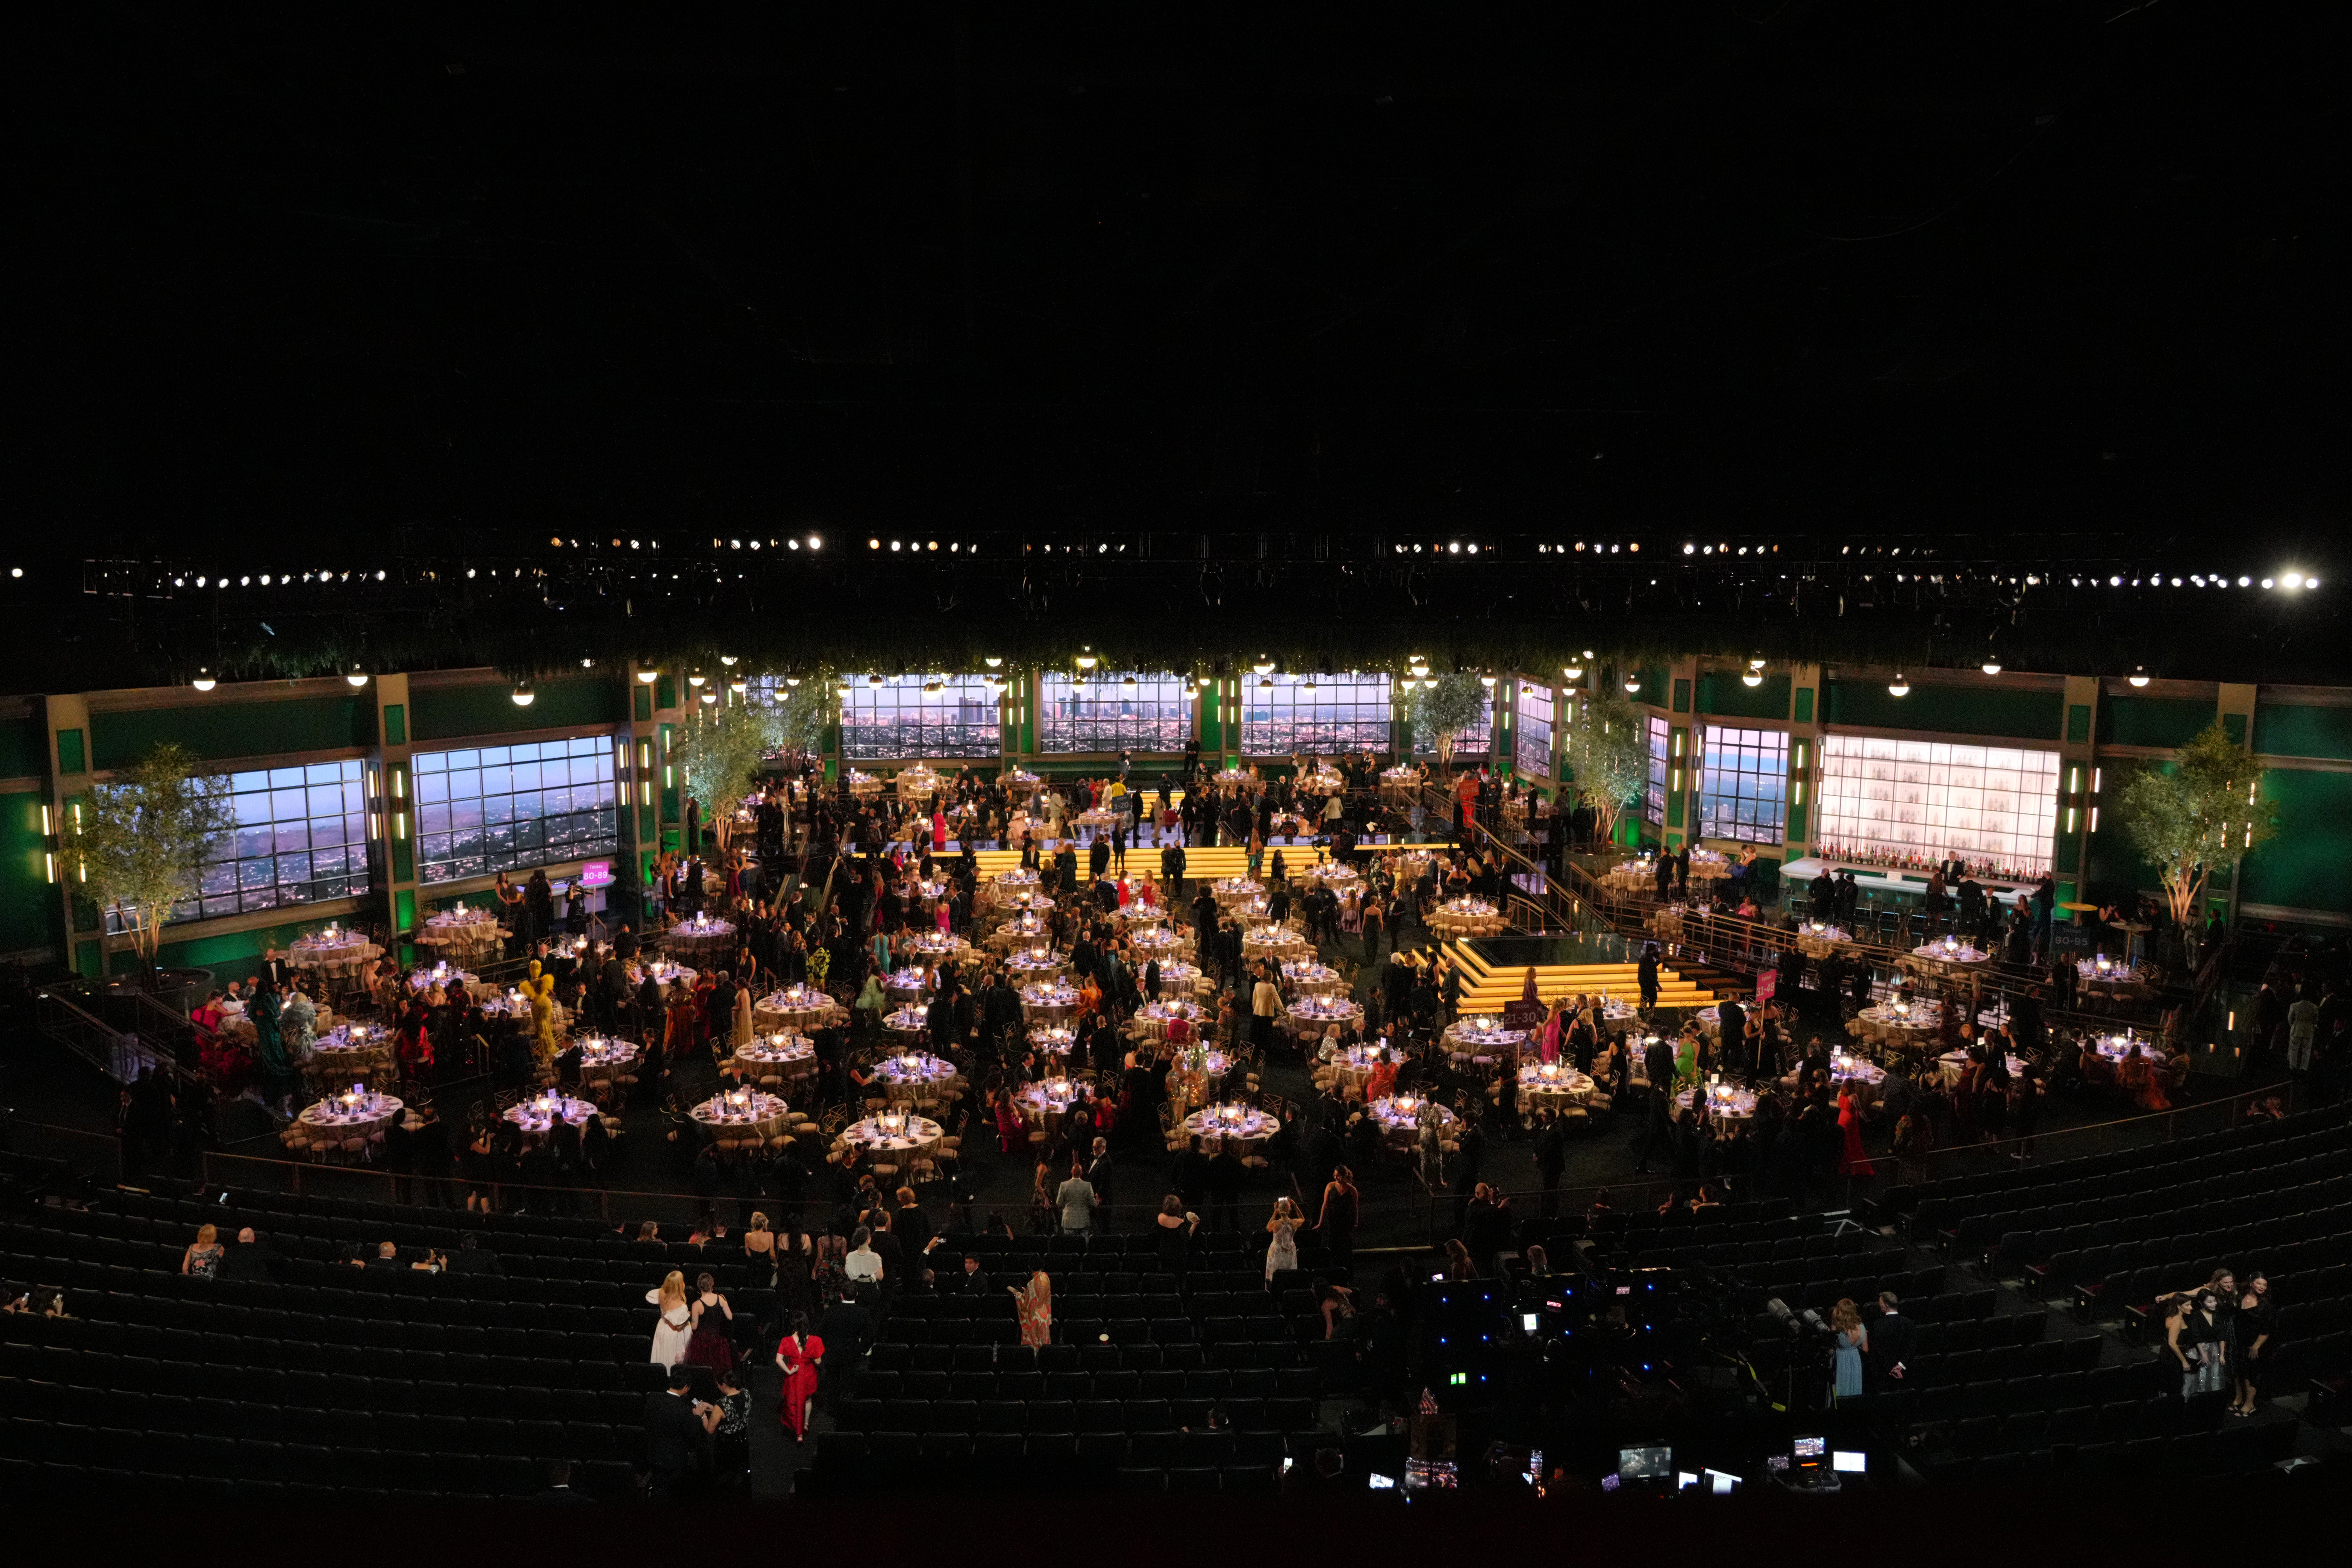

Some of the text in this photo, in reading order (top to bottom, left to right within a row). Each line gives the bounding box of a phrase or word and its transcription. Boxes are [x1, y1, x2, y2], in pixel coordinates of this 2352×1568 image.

[1114, 802, 1129, 810] 1-20
[584, 871, 608, 880] 80-89
[2055, 936, 2088, 946] 90-95
[1756, 982, 1775, 997] 31-49
[1505, 1012, 1536, 1024] 21-30
